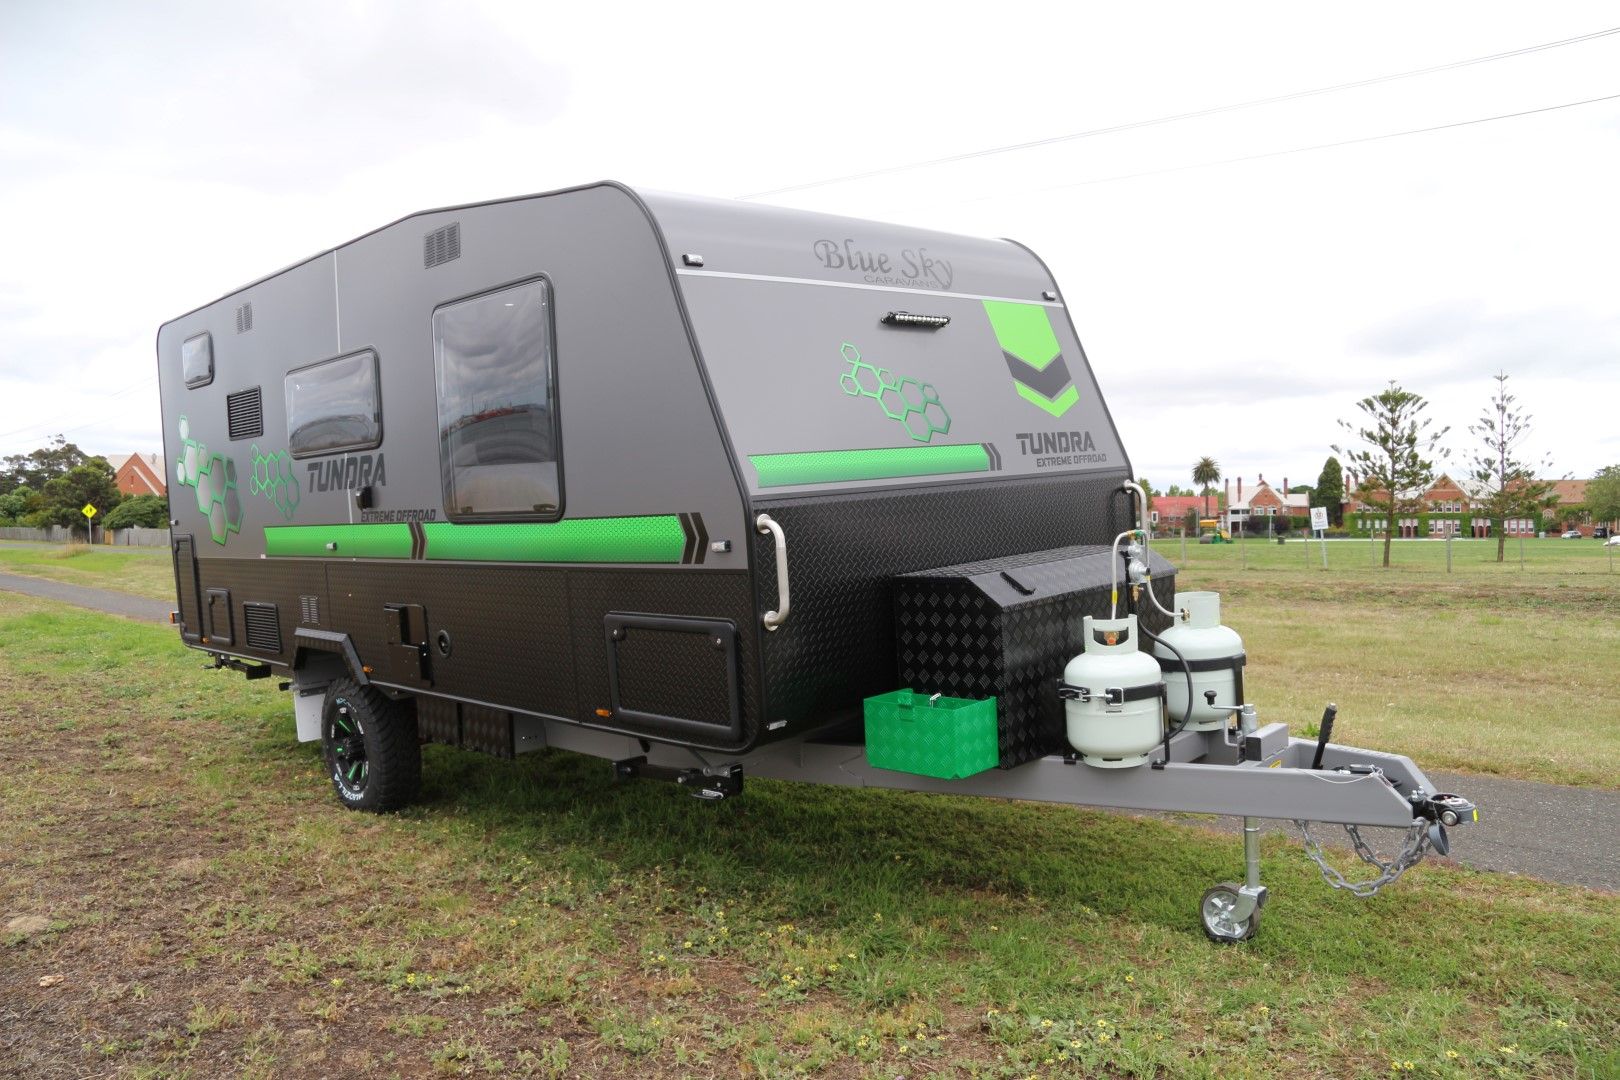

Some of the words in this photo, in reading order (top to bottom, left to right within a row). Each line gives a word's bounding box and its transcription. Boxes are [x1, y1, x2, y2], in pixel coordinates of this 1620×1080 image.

[814, 238, 892, 273] Blue
[901, 248, 953, 290] Sky
[863, 274, 940, 289] CARAVANS
[1015, 431, 1096, 455] TUNDRA
[1036, 455, 1072, 467] EXTREME
[1073, 453, 1107, 464] OFFROAD
[307, 453, 386, 493] TUNDRA
[361, 510, 395, 523] EXTREME
[396, 508, 437, 521] OFFROAD
